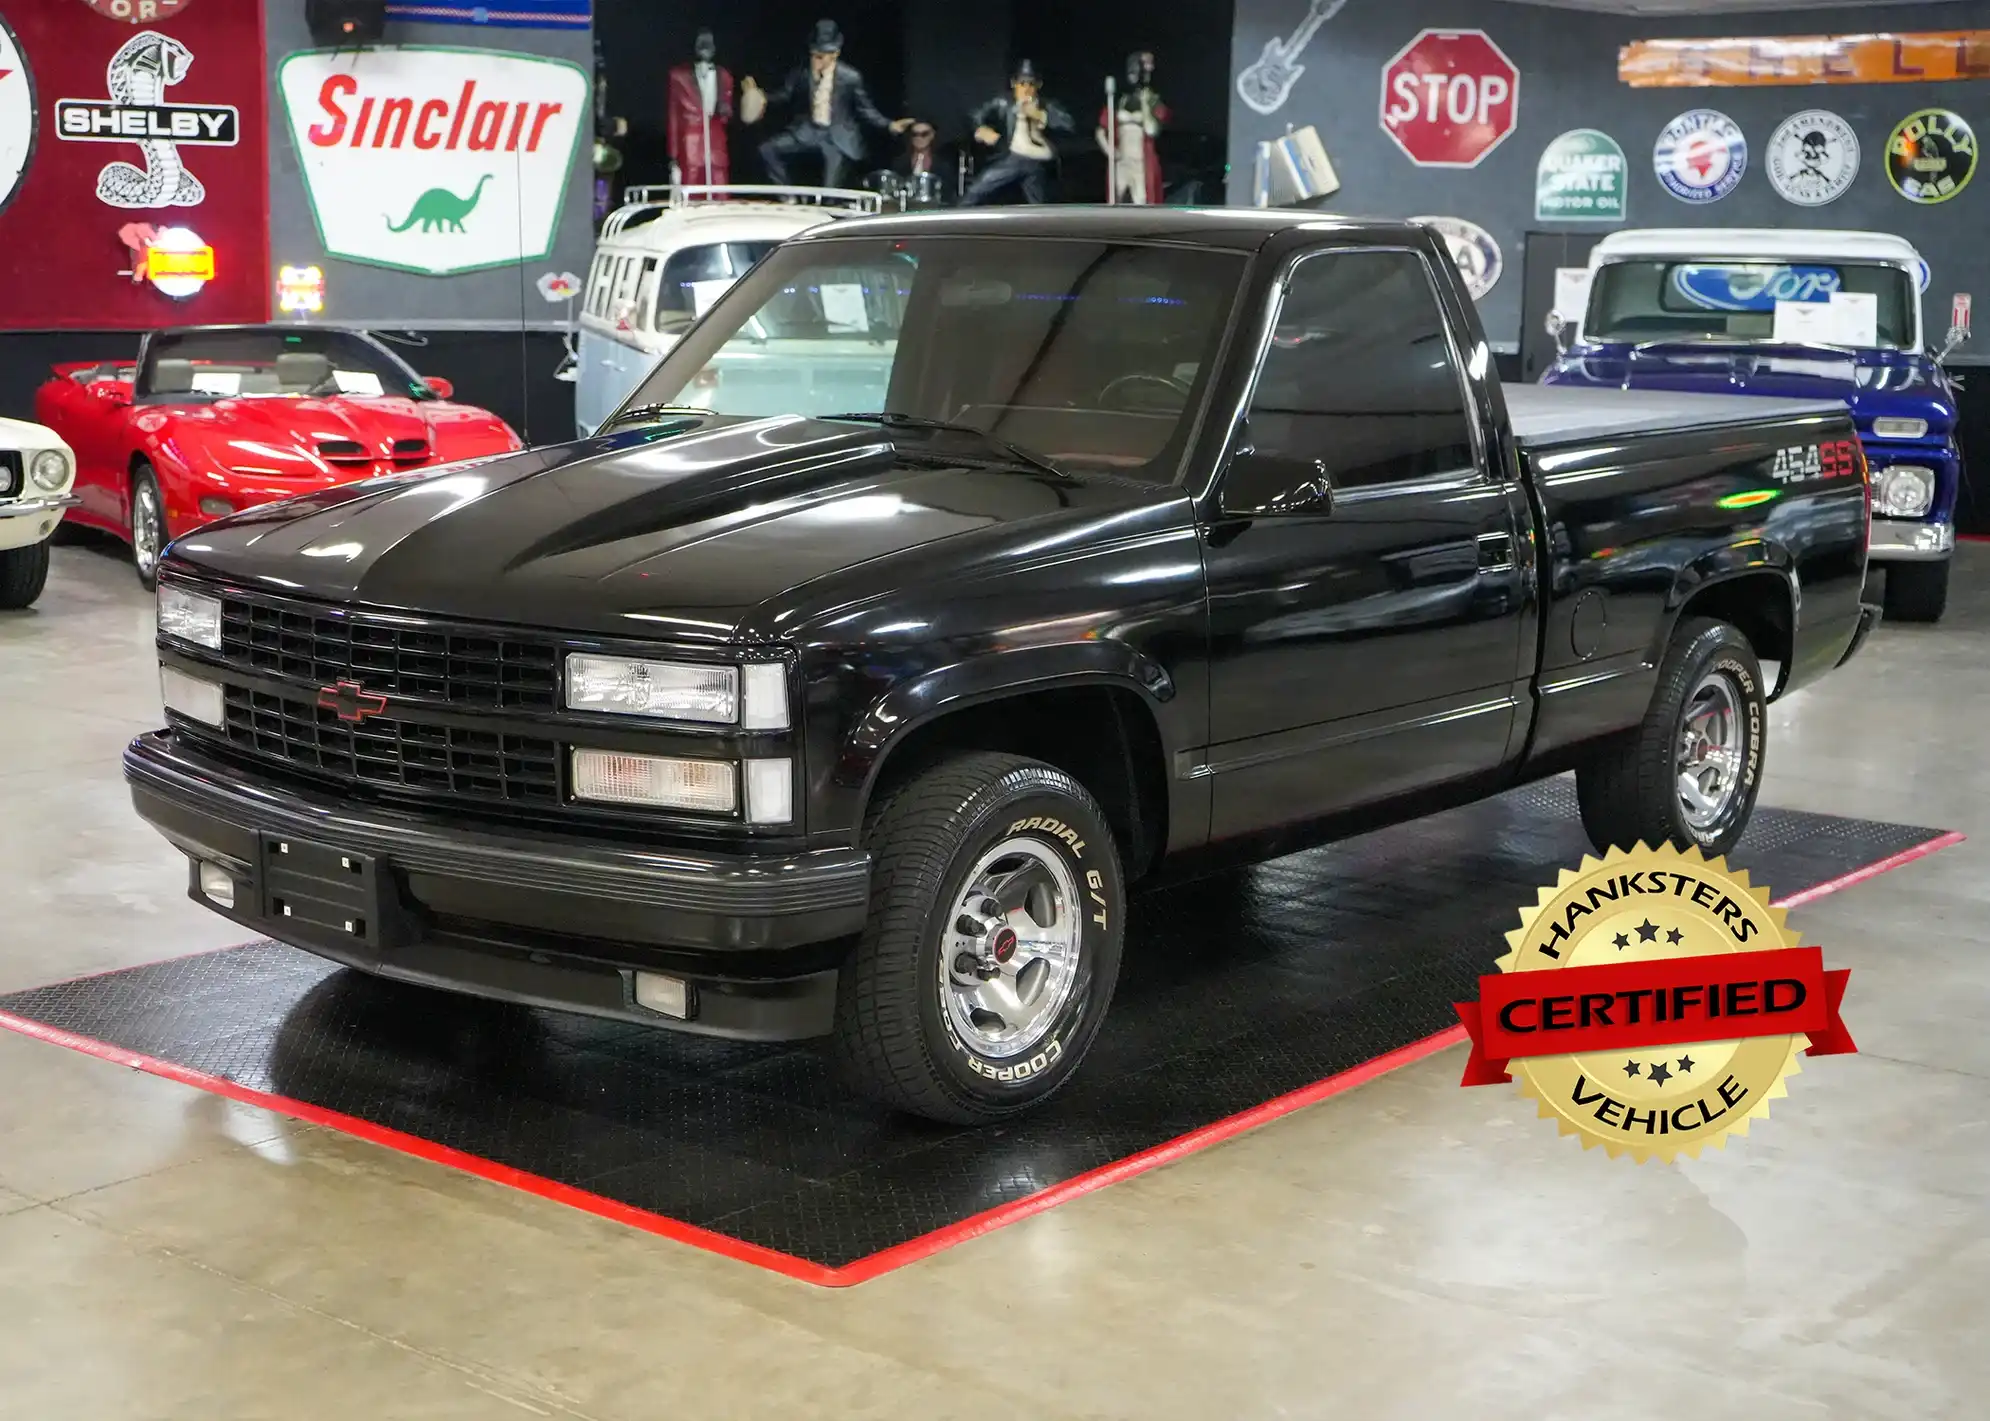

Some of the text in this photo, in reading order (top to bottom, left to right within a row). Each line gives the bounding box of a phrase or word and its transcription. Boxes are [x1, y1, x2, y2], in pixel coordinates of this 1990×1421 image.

[308, 73, 563, 152] Sinclair
[1391, 71, 1508, 125] STOP
[64, 108, 228, 137] SHELBY
[1891, 114, 1973, 157] POLLY
[1547, 172, 1615, 191] STATE
[1595, 196, 1620, 209] OIL
[1903, 175, 1955, 198] GAS
[1711, 658, 1760, 787] COOPER COBRA
[1006, 817, 1107, 931] RADIAL G/T
[968, 1040, 1062, 1081] COOPER
